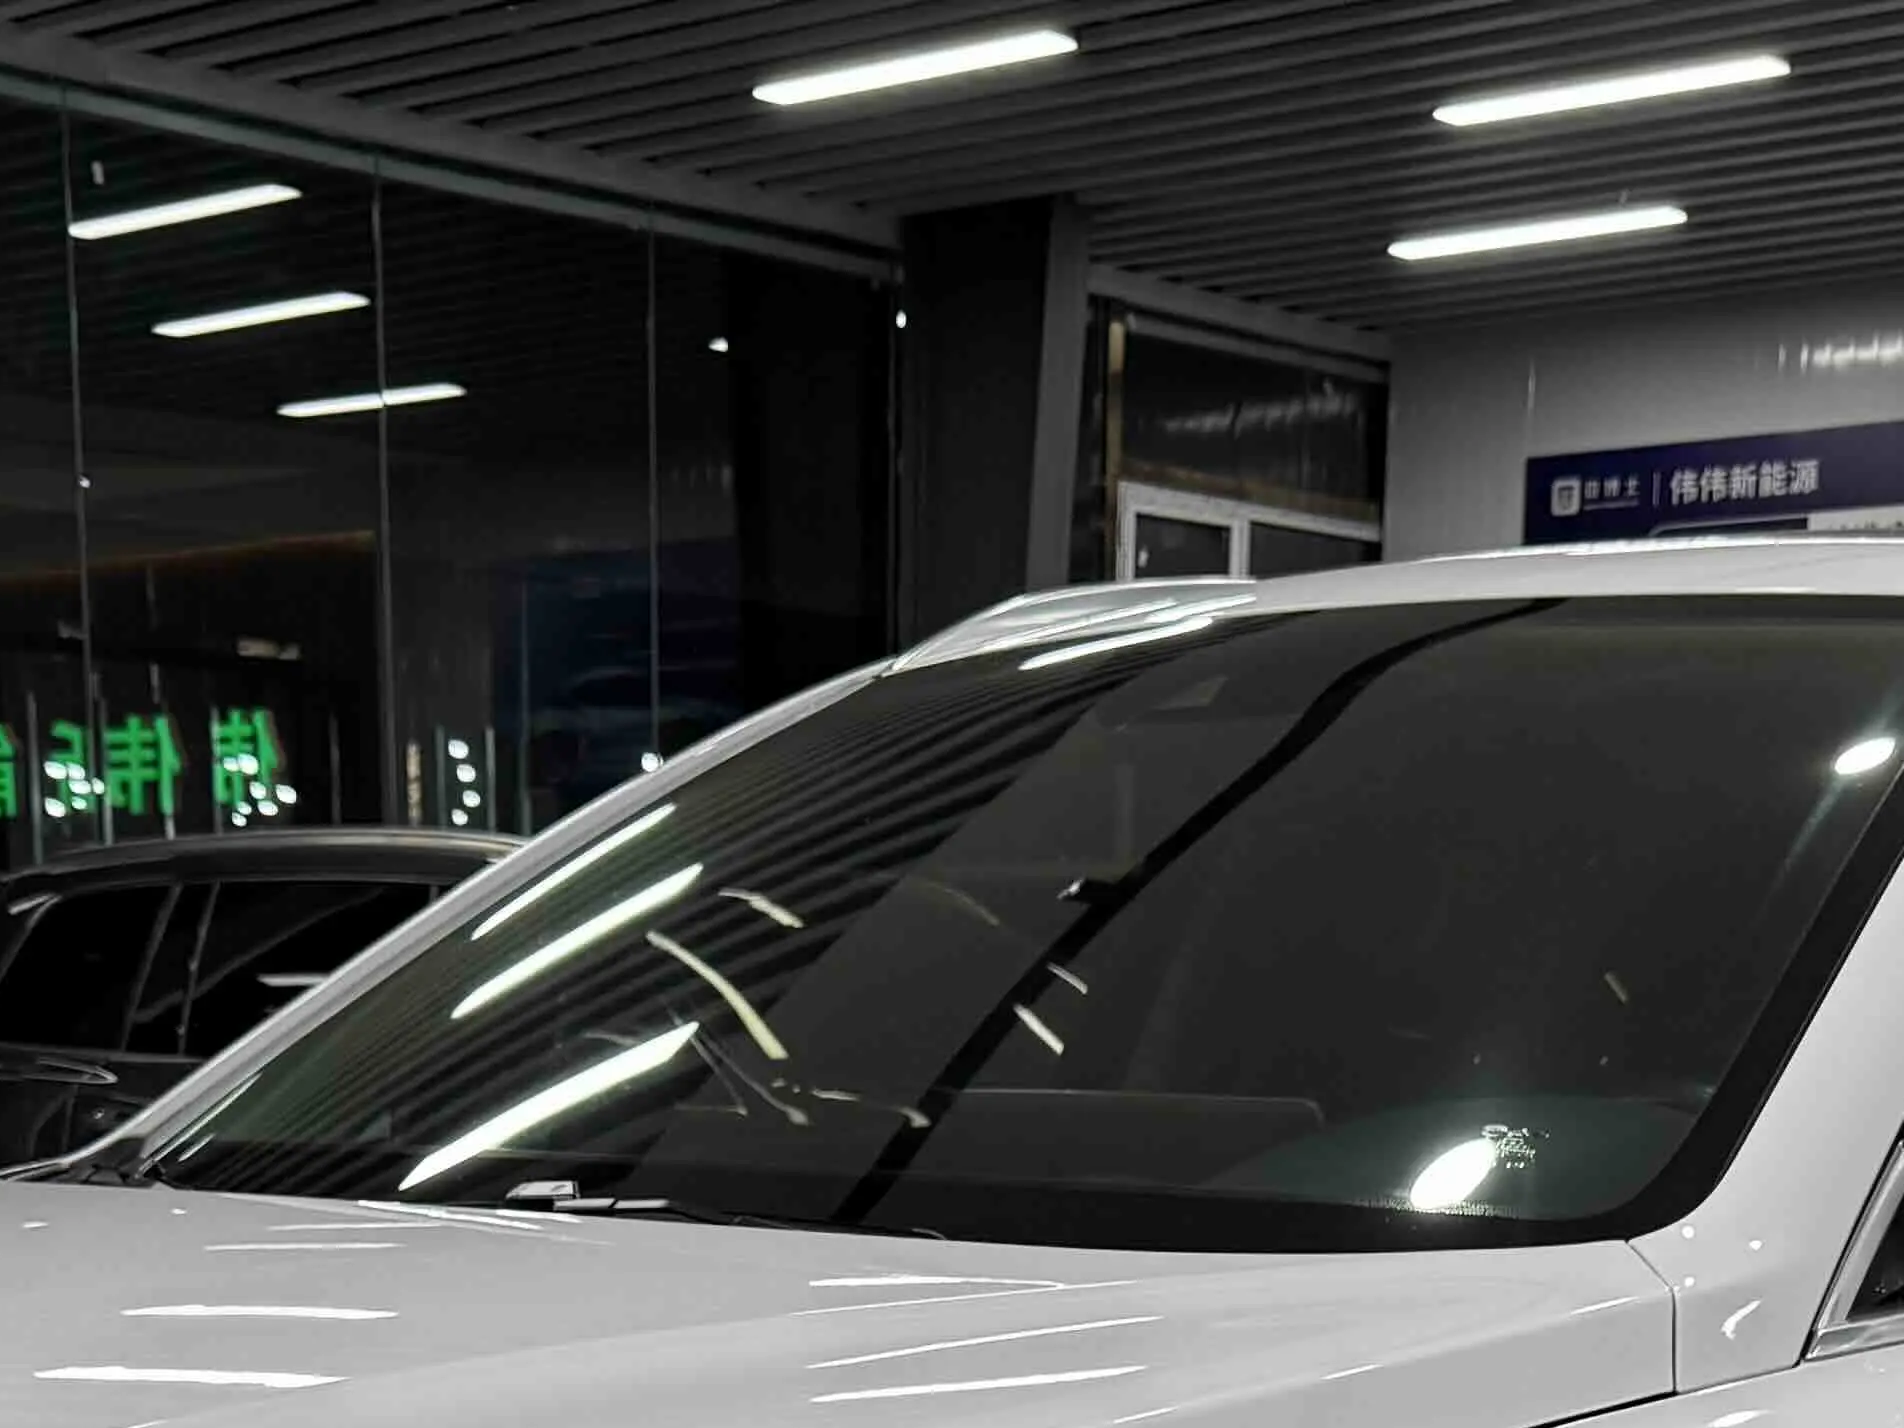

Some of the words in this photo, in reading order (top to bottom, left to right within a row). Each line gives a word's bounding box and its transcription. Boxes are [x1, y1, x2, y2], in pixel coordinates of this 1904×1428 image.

[1669, 459, 1820, 507] 伟伟新能源
